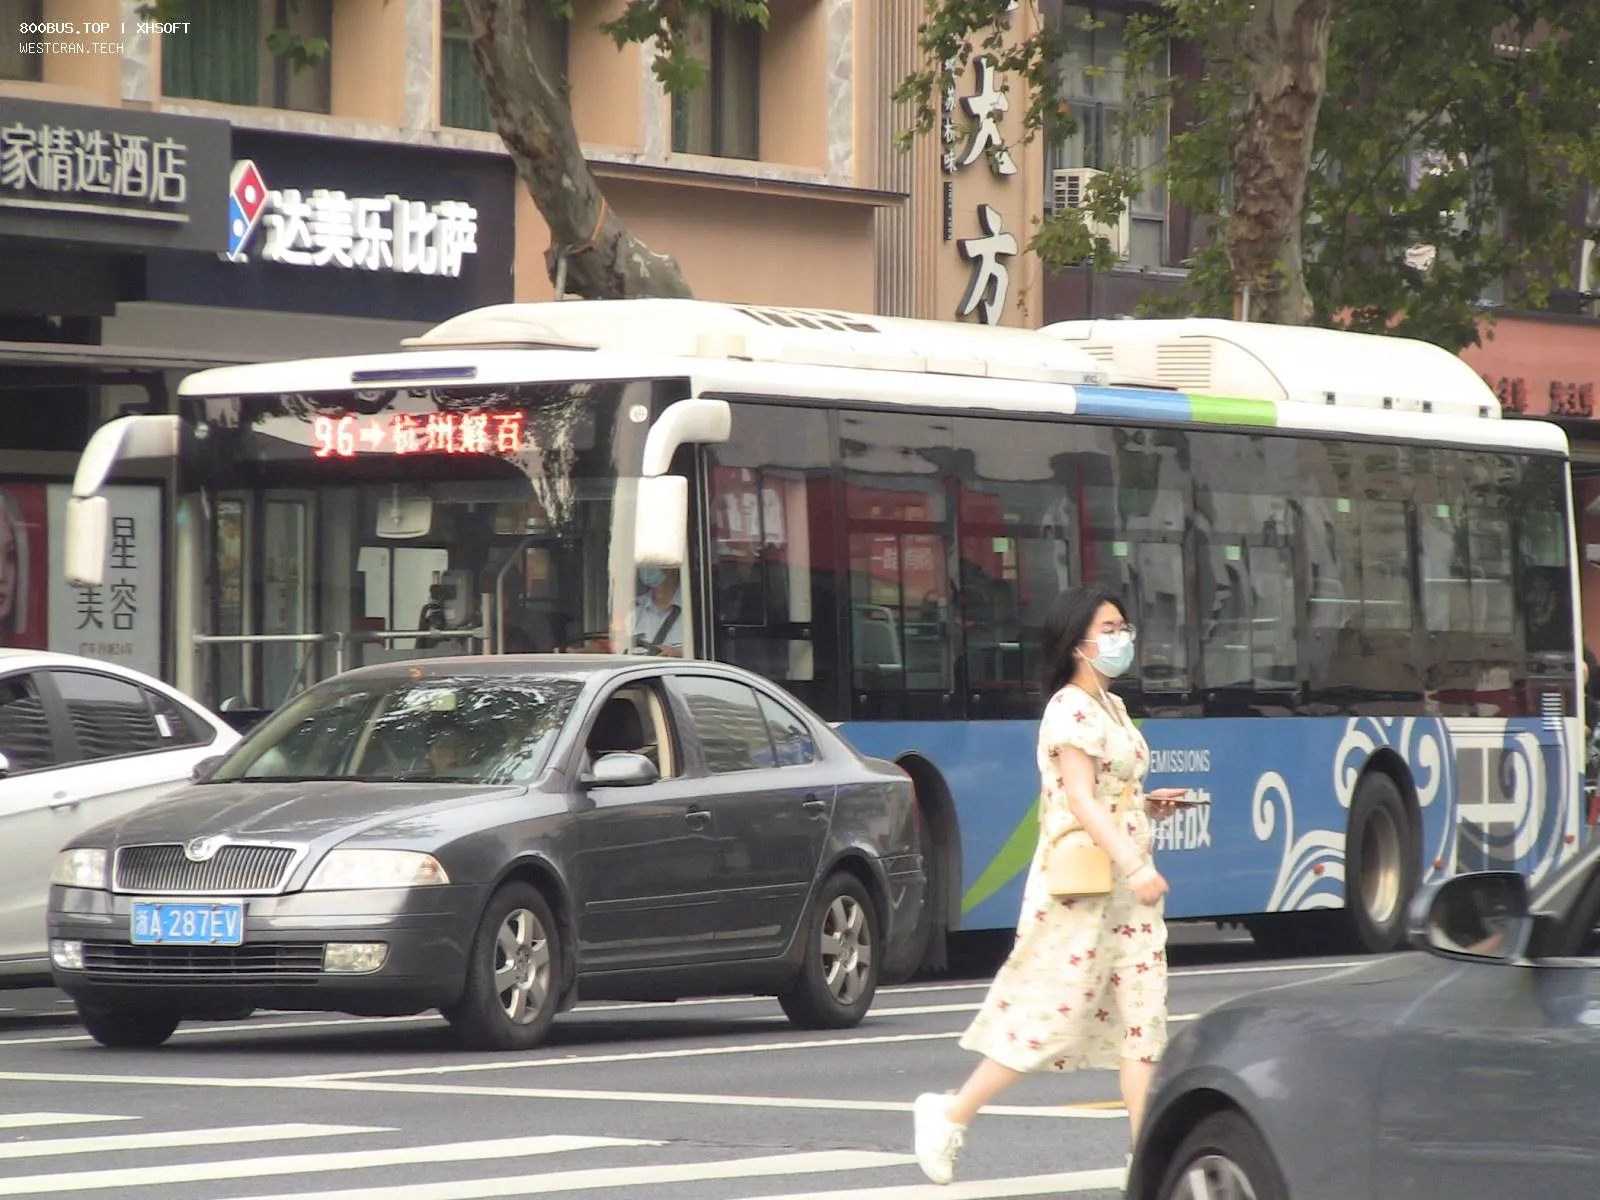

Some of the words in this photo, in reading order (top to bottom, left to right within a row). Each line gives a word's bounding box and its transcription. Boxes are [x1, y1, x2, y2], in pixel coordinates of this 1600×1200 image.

[0, 121, 188, 203] 家精选酒店
[262, 188, 478, 278] 达美乐比萨
[314, 415, 356, 457] 96
[1150, 749, 1211, 773] EMISSIONS
